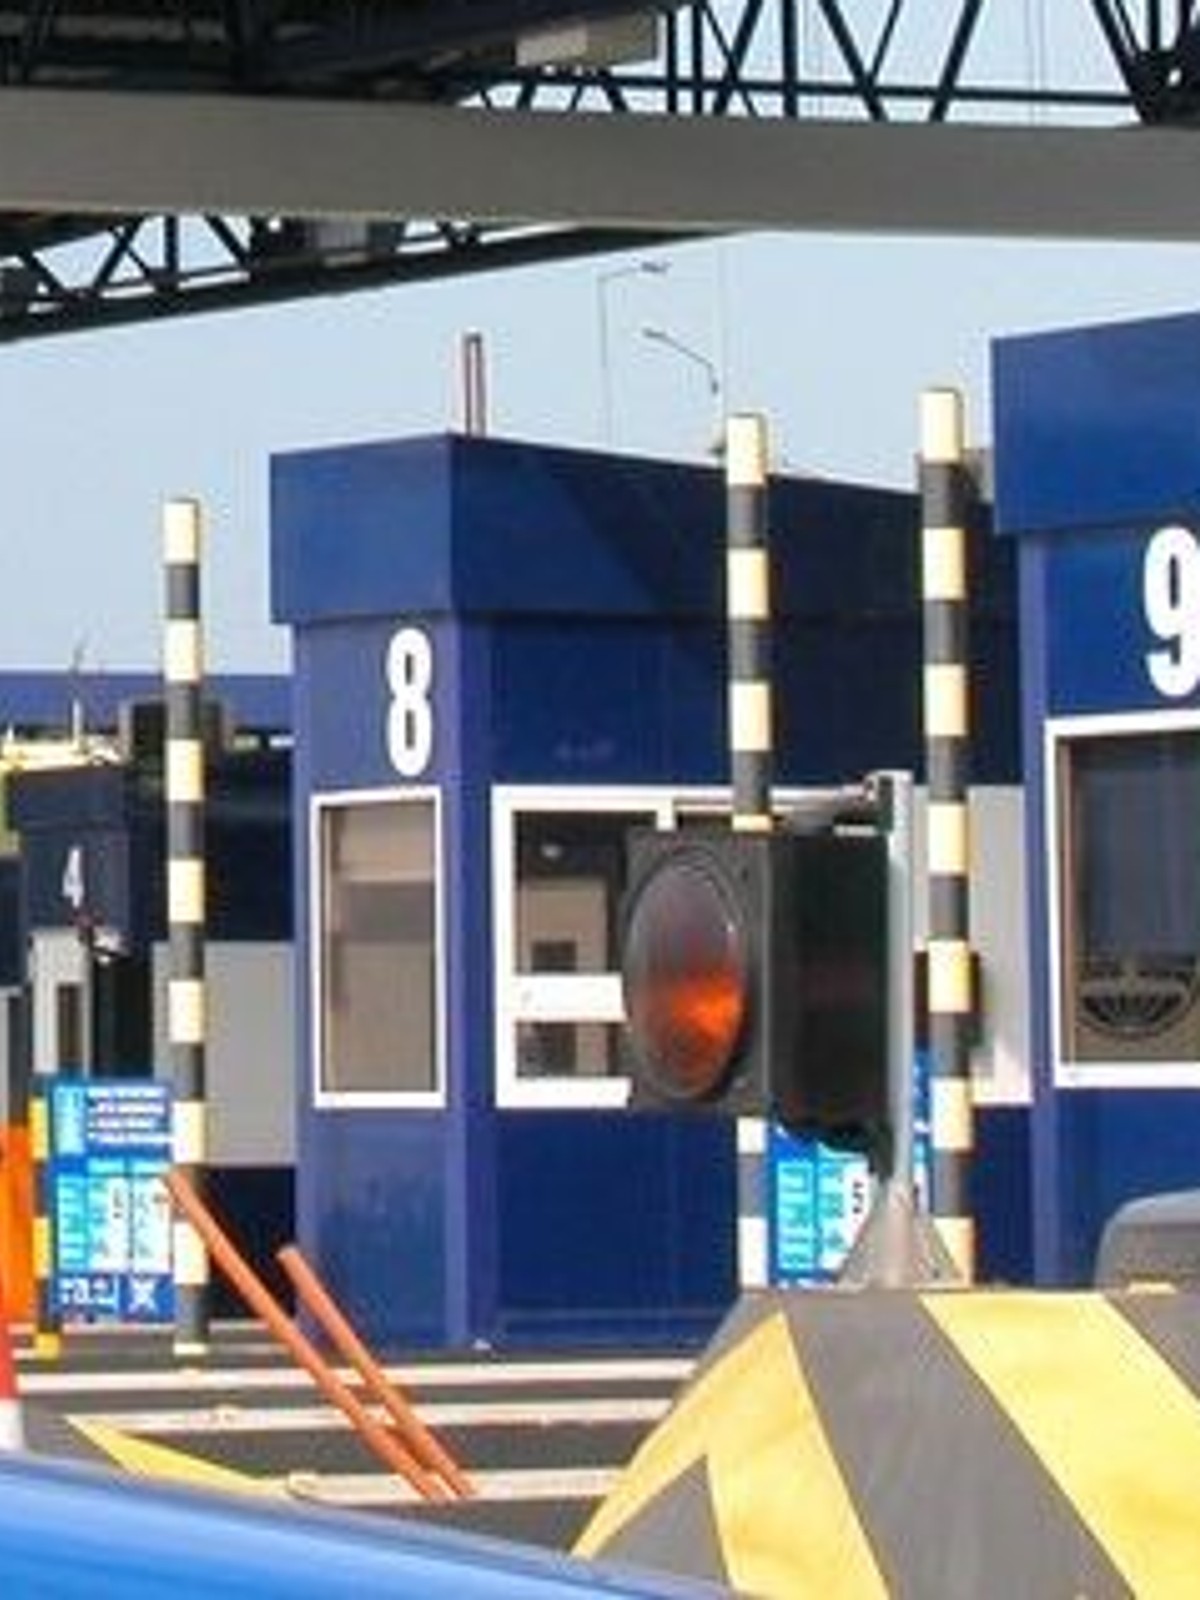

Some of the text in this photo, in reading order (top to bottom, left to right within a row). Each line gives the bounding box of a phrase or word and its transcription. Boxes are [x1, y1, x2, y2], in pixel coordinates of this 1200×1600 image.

[1144, 524, 1200, 698] 9
[386, 627, 433, 777] 8
[62, 848, 84, 909] 4
